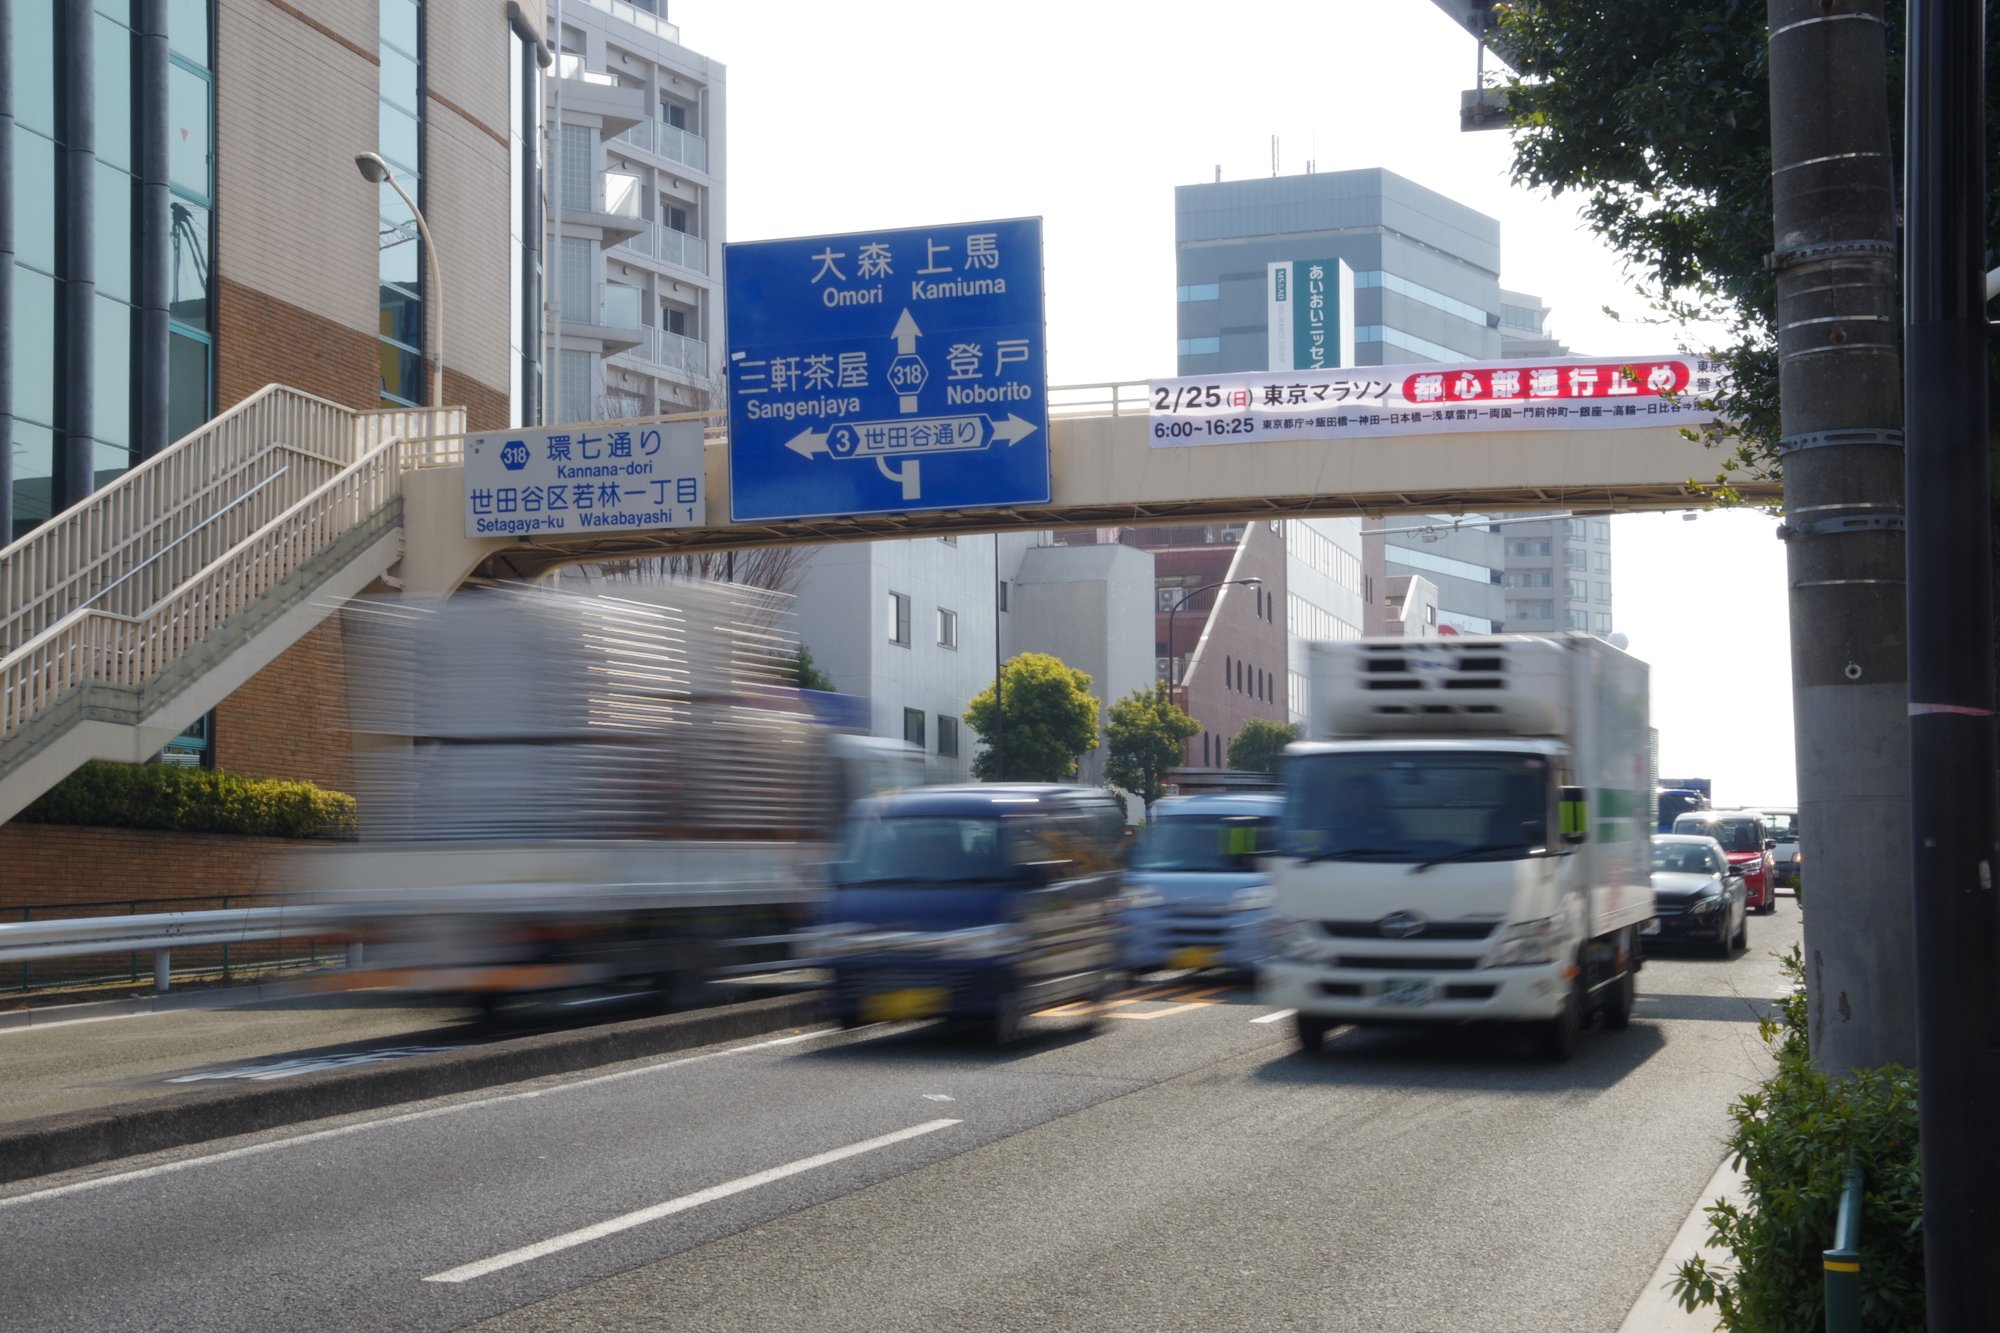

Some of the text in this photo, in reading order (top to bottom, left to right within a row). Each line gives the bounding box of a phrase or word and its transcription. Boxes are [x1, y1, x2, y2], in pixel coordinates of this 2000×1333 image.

[811, 233, 999, 284] 大森 上馬
[822, 277, 1006, 308] Omori Kamiuma
[738, 351, 869, 394] 三軒茶屋
[946, 339, 1030, 381] 登戸
[894, 363, 922, 385] 318
[1413, 364, 1677, 402] 都心部通行止め
[946, 381, 1032, 405] Noborito
[1262, 380, 1393, 406] 東京マラソン
[746, 396, 861, 420] Sangenjaya
[546, 430, 662, 462] 環七通り
[835, 431, 851, 452] 3
[864, 421, 977, 449] 世田谷通り
[504, 447, 527, 465] 318
[557, 460, 653, 479] Kannana-dori
[470, 477, 697, 515] 世田谷区若林一丁目
[476, 508, 694, 534] Setagaya-ku Wakabayashi 1
